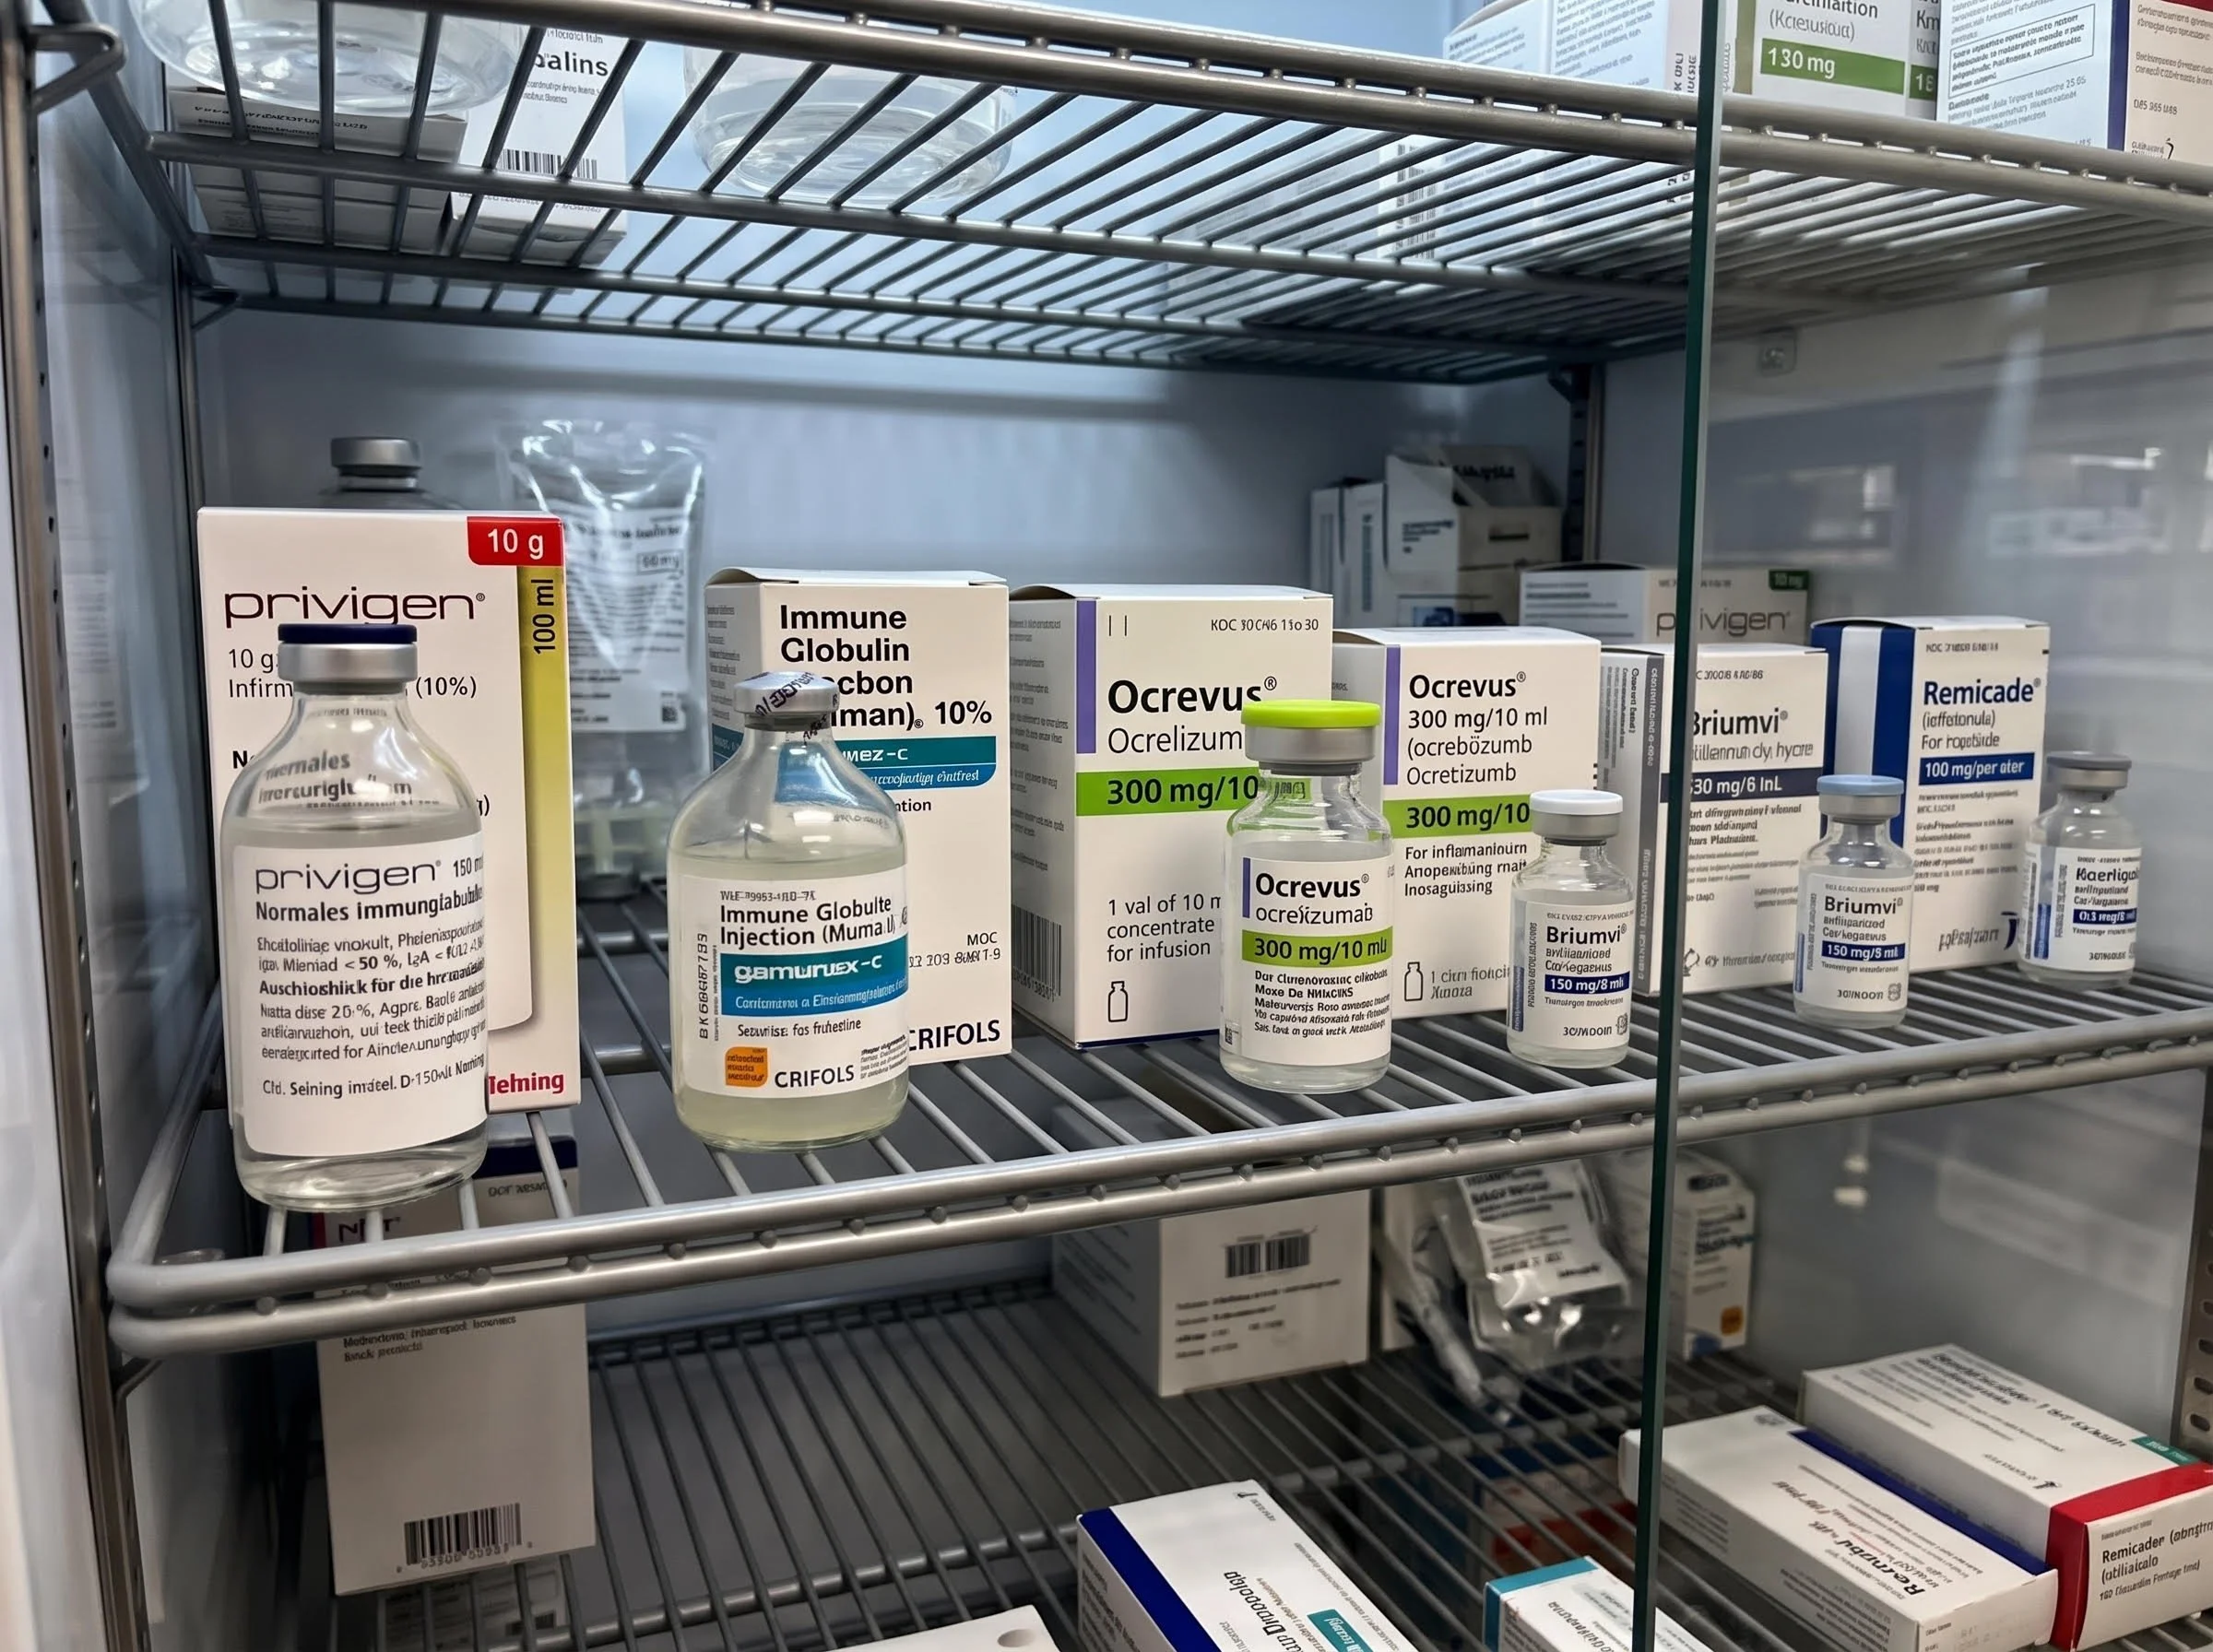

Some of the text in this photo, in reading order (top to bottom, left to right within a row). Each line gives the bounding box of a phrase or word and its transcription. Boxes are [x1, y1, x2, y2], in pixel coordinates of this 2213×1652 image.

[1769, 48, 1835, 79] 130 mg
[488, 528, 544, 560] 10 g
[531, 578, 556, 655] 100 ml
[780, 605, 907, 630] Immune
[1657, 608, 1786, 637] pivigen
[230, 649, 254, 669] 10
[780, 636, 910, 663] Globulin
[415, 676, 478, 699] (10%)
[821, 673, 914, 695] cbon
[934, 700, 992, 726] 10%
[1408, 706, 1547, 733] 300 mg/10 ml
[1922, 734, 1943, 750] For
[1925, 761, 1949, 778] 100
[1951, 761, 1998, 780] mg/per
[1106, 774, 1259, 809] 300 mg/10
[1716, 776, 1756, 797] mg/6
[1406, 802, 1531, 832] 300 mg/10
[1405, 846, 1428, 860] For
[255, 901, 349, 922] Normales
[720, 896, 892, 923] Immune Globulte
[1108, 899, 1117, 915] 1
[1125, 895, 1151, 915] val
[1157, 894, 1178, 913] of
[1183, 893, 1204, 911] 10
[720, 926, 815, 950] Injection
[1106, 916, 1215, 939] concentrate
[967, 932, 998, 947] MOC
[1106, 939, 1212, 962] for infusion
[1828, 944, 1847, 957] 150
[359, 956, 378, 970] 50
[1254, 938, 1293, 960] 300
[1298, 939, 1363, 966] mg/10
[1551, 978, 1573, 991] 150
[343, 1044, 364, 1058] for
[775, 1065, 855, 1088] CRIFOLS
